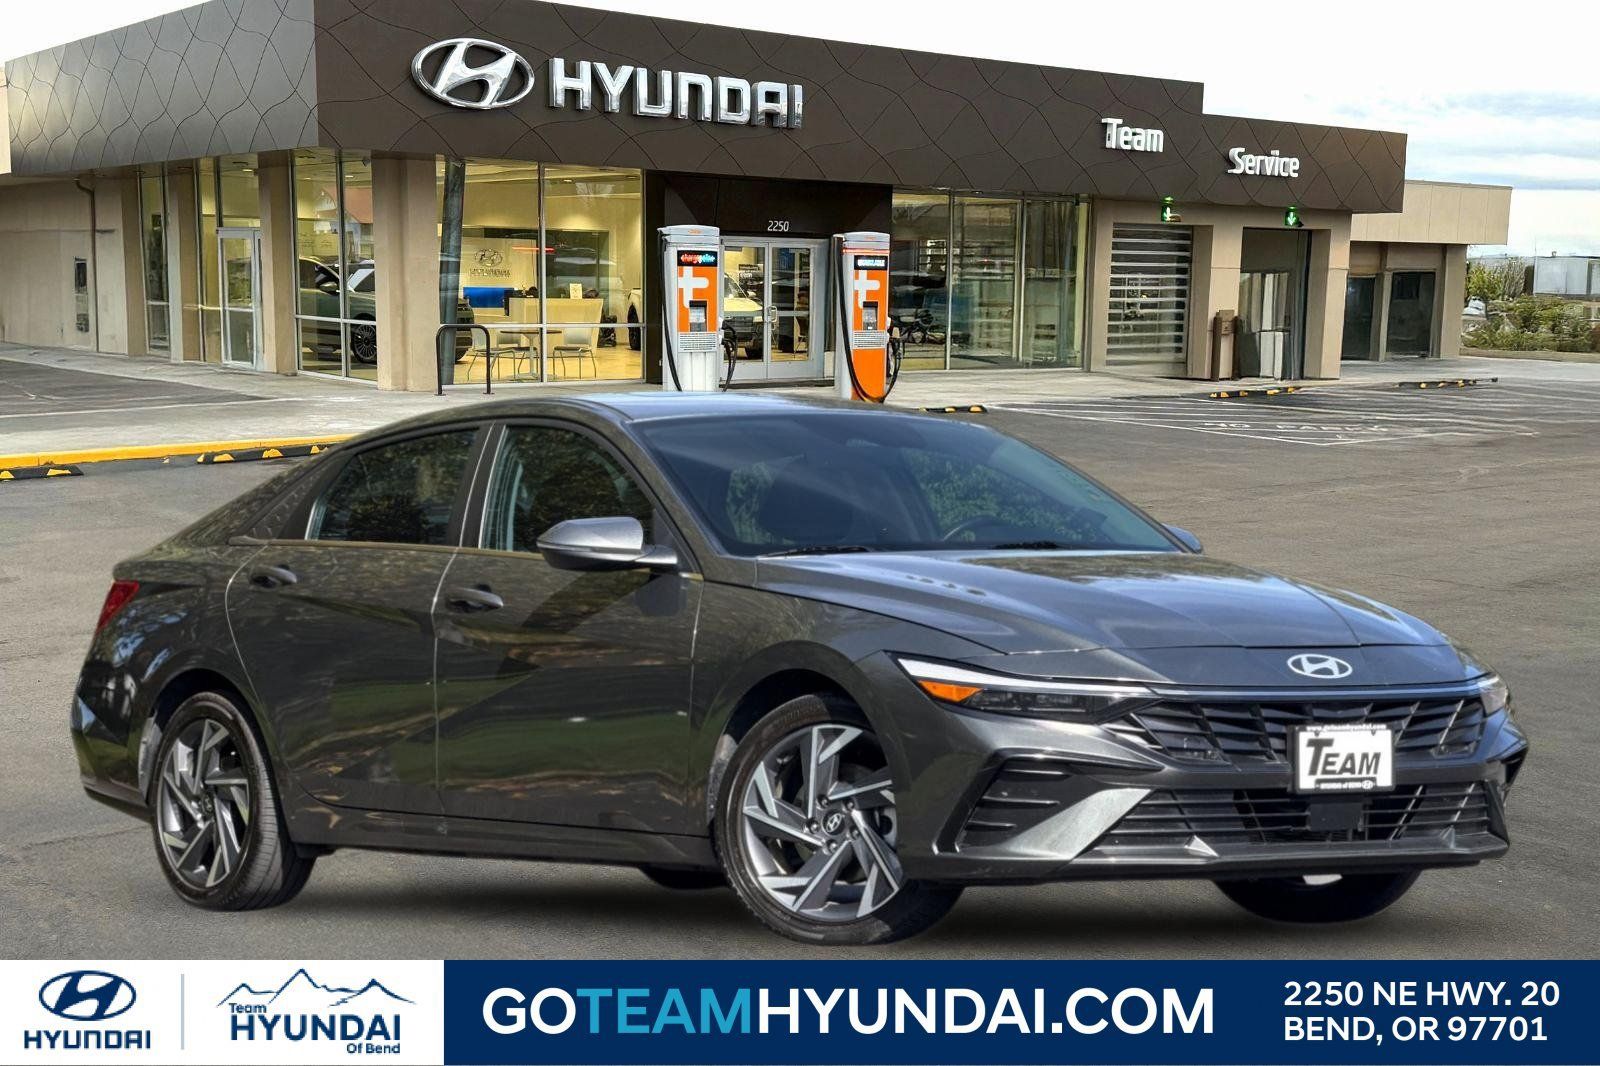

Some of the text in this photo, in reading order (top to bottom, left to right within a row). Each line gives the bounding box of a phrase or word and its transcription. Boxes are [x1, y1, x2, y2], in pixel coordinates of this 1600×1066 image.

[549, 57, 804, 129] HYUNDAI
[1101, 117, 1164, 153] Team
[1228, 147, 1300, 178] Service
[767, 220, 790, 232] 2250
